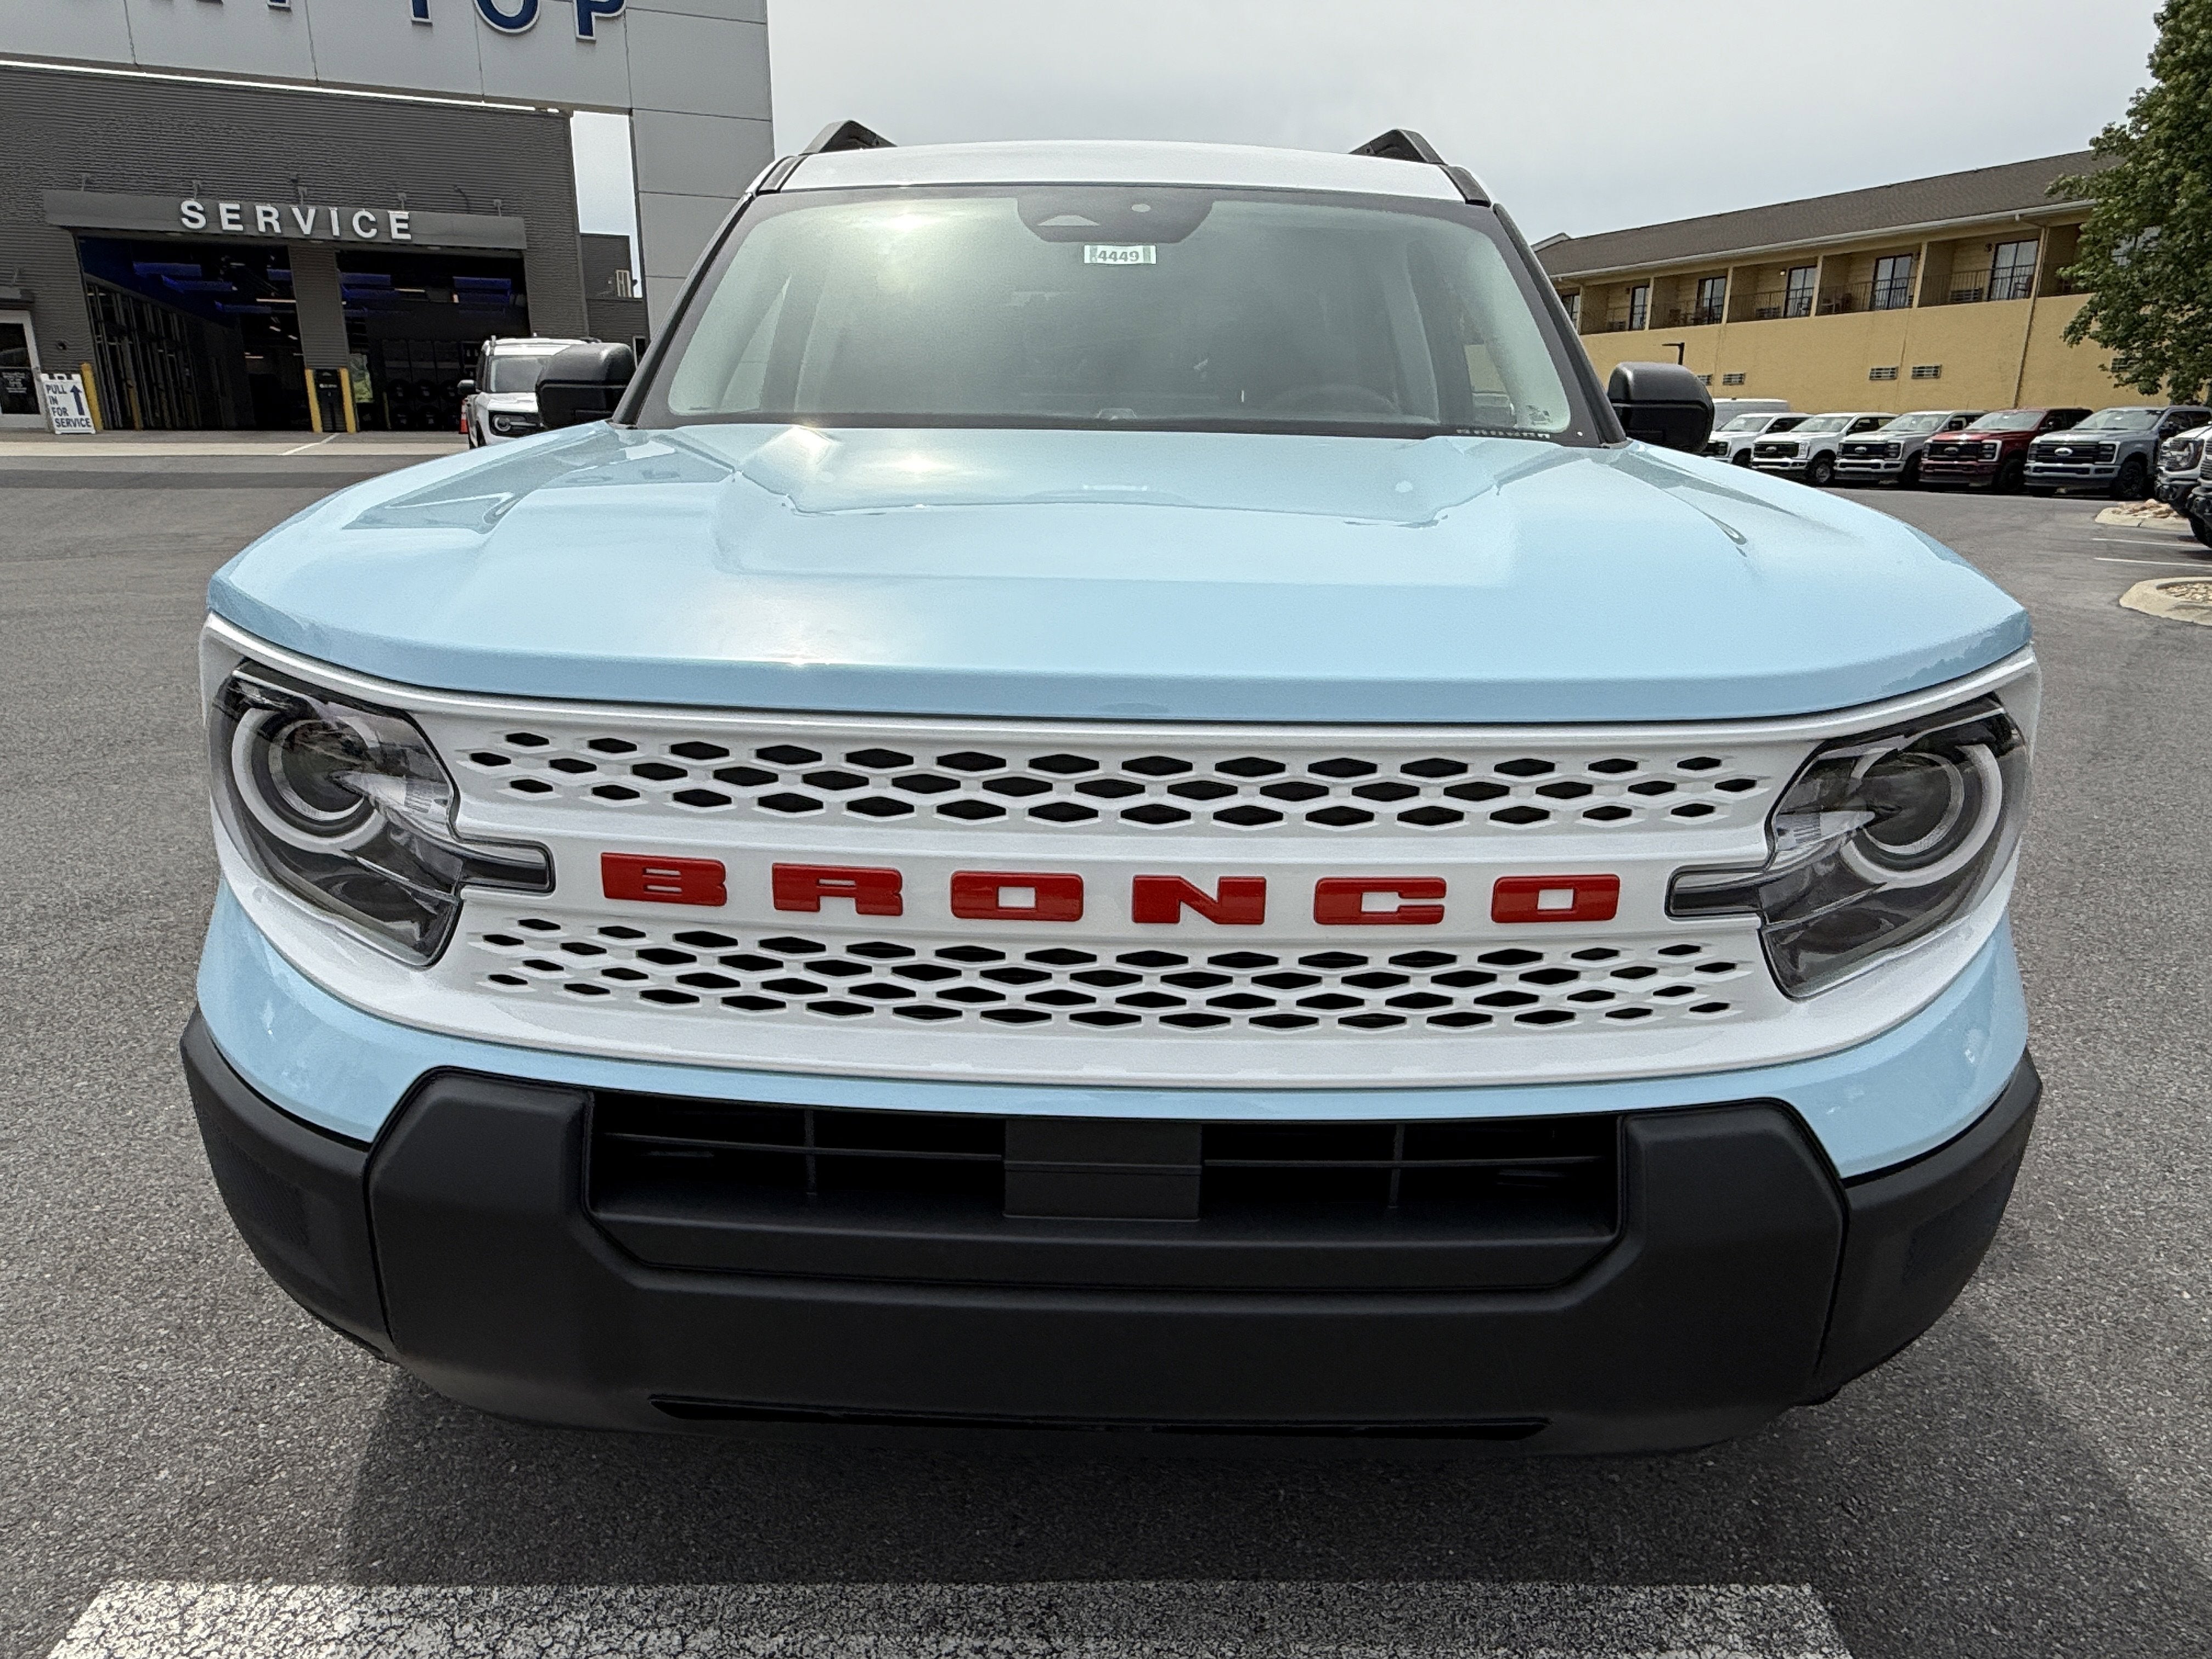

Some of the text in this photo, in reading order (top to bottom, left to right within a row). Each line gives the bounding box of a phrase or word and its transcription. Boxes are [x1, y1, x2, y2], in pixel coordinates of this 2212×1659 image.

[180, 200, 411, 240] SERVICE
[1098, 250, 1139, 262] 4449
[46, 384, 66, 394] PULL
[48, 396, 58, 404] IN
[52, 407, 69, 416] FOR
[55, 417, 92, 427] SERVICE
[601, 852, 1620, 926] BRONCO
